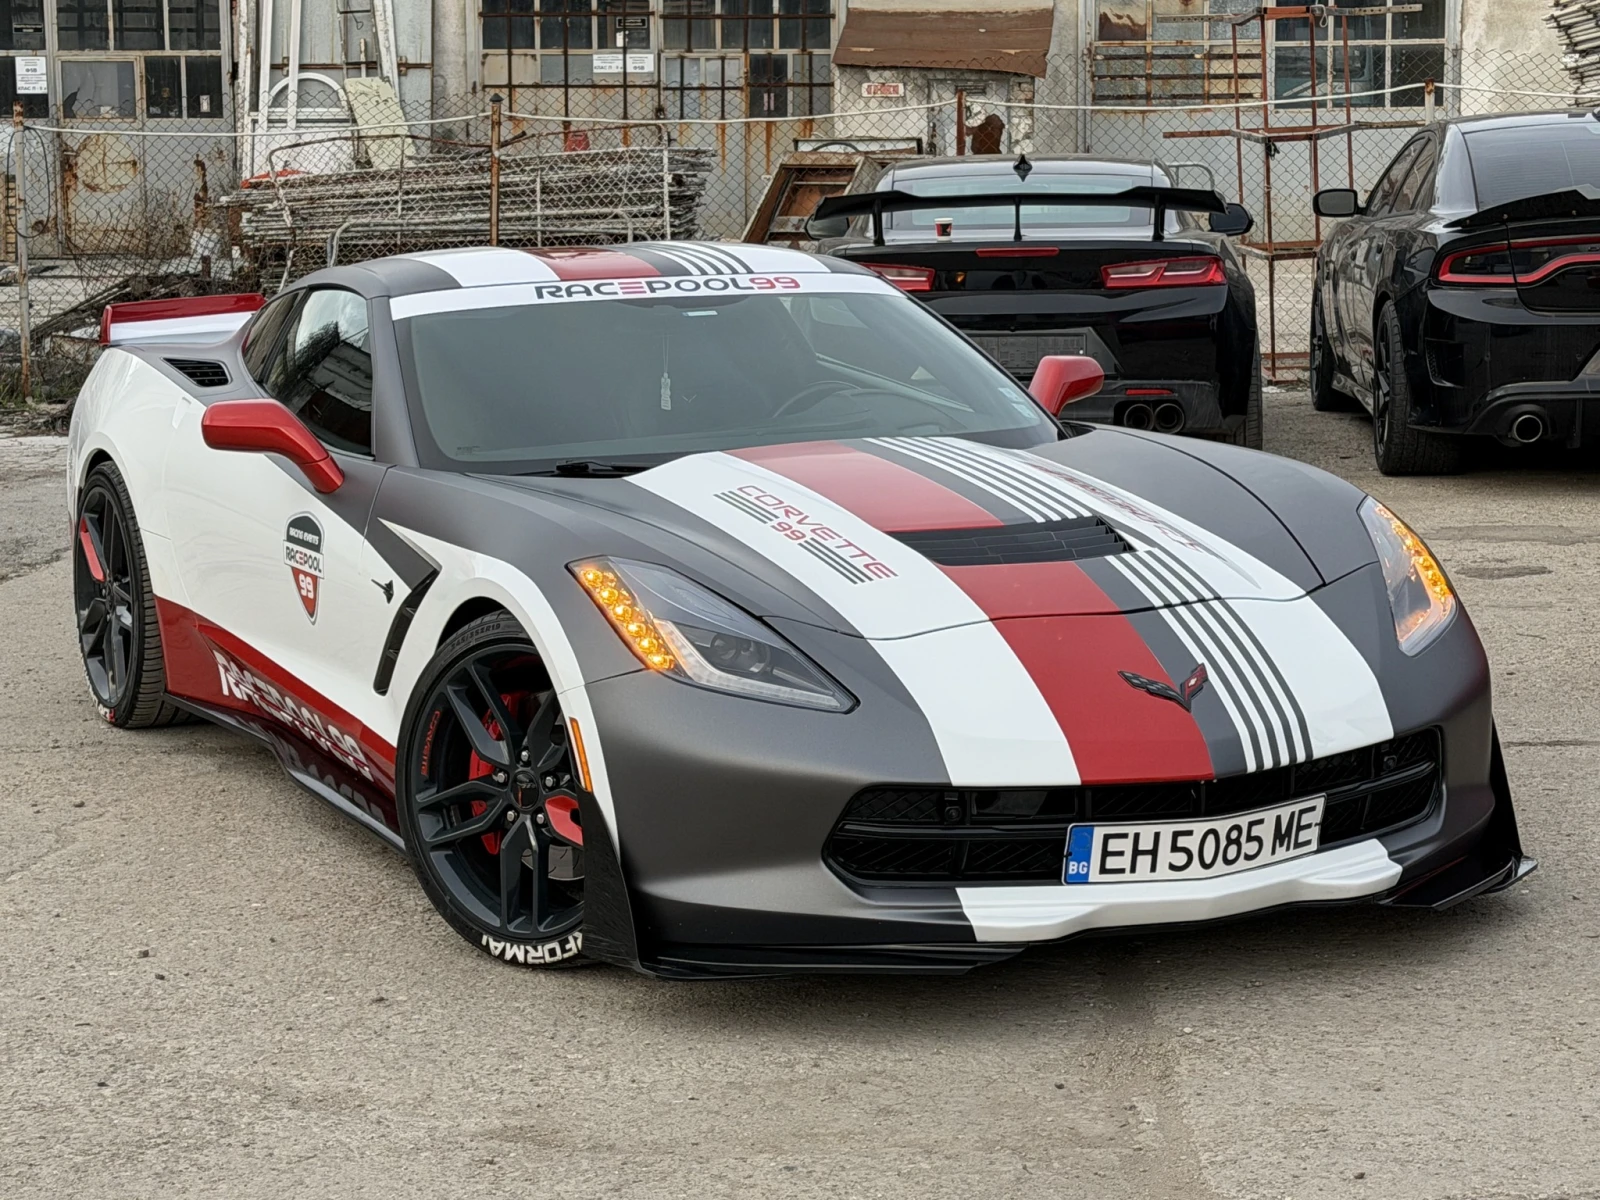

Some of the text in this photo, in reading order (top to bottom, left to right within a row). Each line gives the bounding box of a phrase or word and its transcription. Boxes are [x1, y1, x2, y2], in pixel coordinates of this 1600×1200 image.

[534, 276, 801, 299] RACEPOOL99
[737, 485, 899, 579] CORVETTE
[770, 521, 807, 541] 99
[286, 546, 322, 573] RACEPOOL
[299, 573, 314, 599] 99
[1068, 861, 1088, 875] BG
